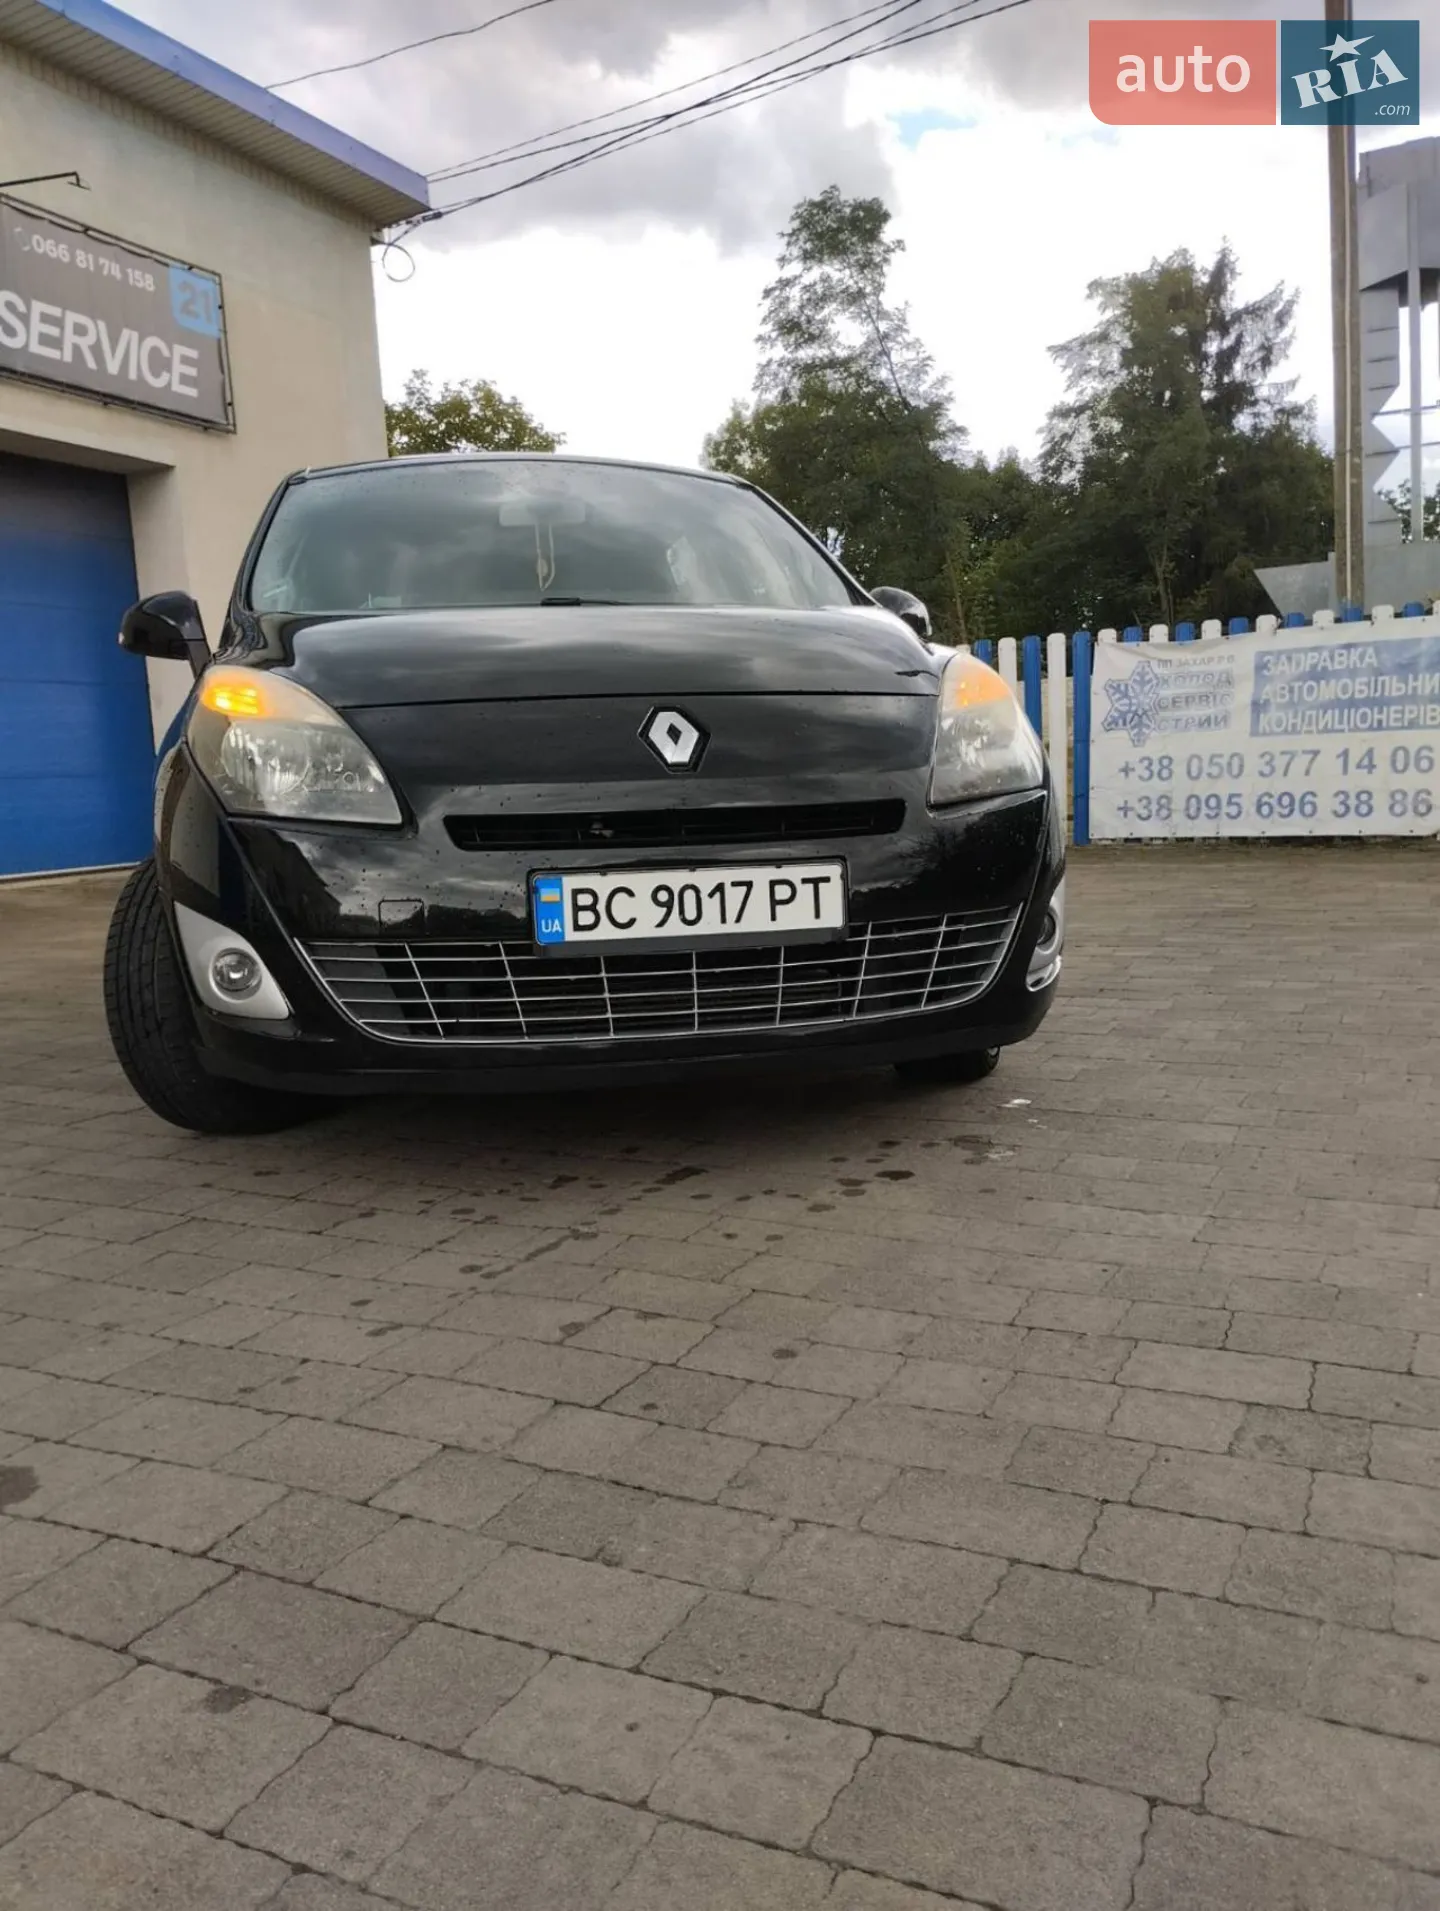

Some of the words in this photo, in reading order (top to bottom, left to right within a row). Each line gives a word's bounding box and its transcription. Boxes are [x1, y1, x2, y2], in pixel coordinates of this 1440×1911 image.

[31, 234, 71, 263] 066
[75, 249, 95, 272] 81
[98, 257, 122, 281] 74
[126, 268, 156, 292] 158
[178, 280, 214, 325] 21
[0, 289, 199, 398] SERVICE
[1262, 647, 1378, 676] ЗАПРАВКА
[1258, 703, 1440, 735] КОНДИЦІОНЕРІВ
[1118, 755, 1174, 782] +38
[1186, 752, 1244, 779] 050
[1258, 750, 1321, 778] 377
[1336, 747, 1377, 776] 14
[1390, 745, 1434, 774] 06
[1117, 794, 1172, 821] +38
[1184, 793, 1243, 821] 095
[1255, 791, 1318, 819] 696
[1331, 790, 1374, 818] 38
[1389, 788, 1433, 818] 86
[571, 886, 637, 932] BC
[650, 880, 753, 928] 9017
[768, 876, 831, 922] PT
[541, 918, 562, 933] UA
